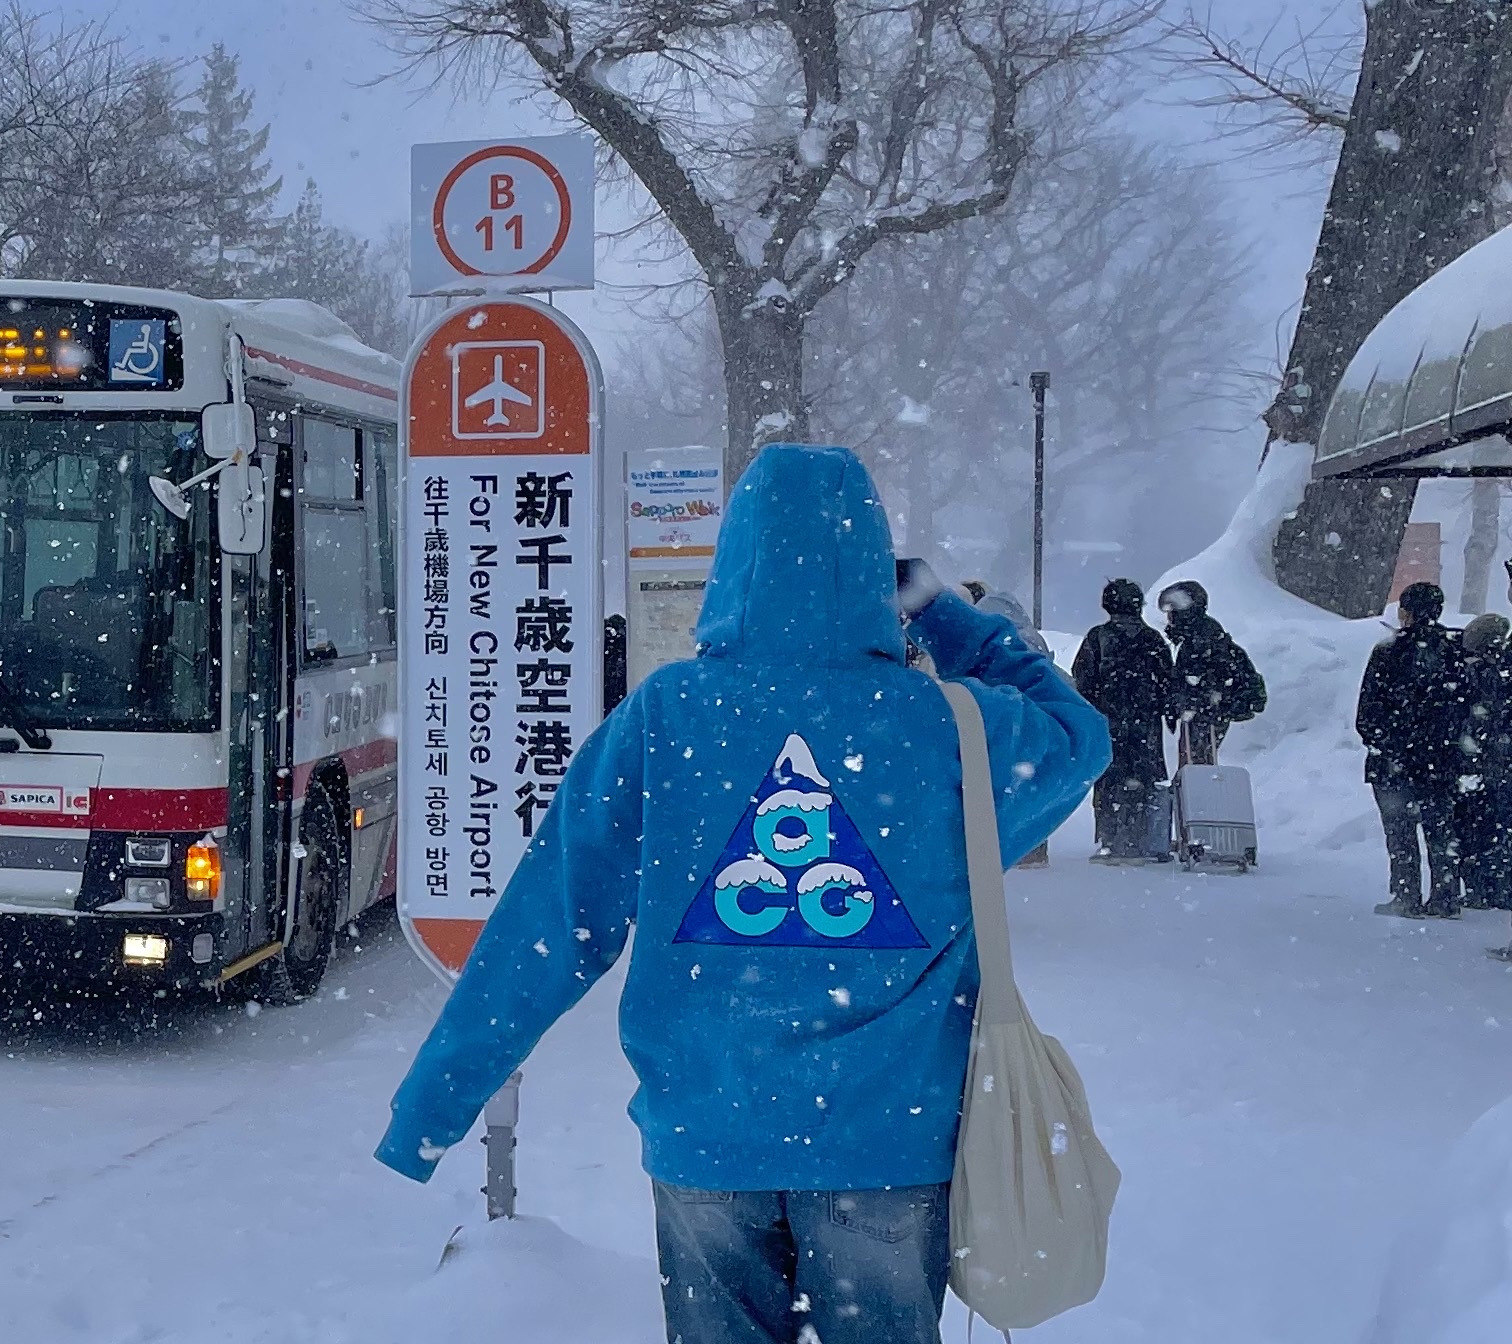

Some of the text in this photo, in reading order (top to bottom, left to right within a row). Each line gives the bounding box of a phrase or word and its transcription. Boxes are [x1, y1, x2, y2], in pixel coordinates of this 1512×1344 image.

[490, 174, 515, 210] B
[475, 214, 523, 251] 11
[462, 474, 499, 899] For New Chitose Airport
[10, 793, 56, 805] SAPICA
[424, 676, 450, 898] 신치토세 공항 방면
